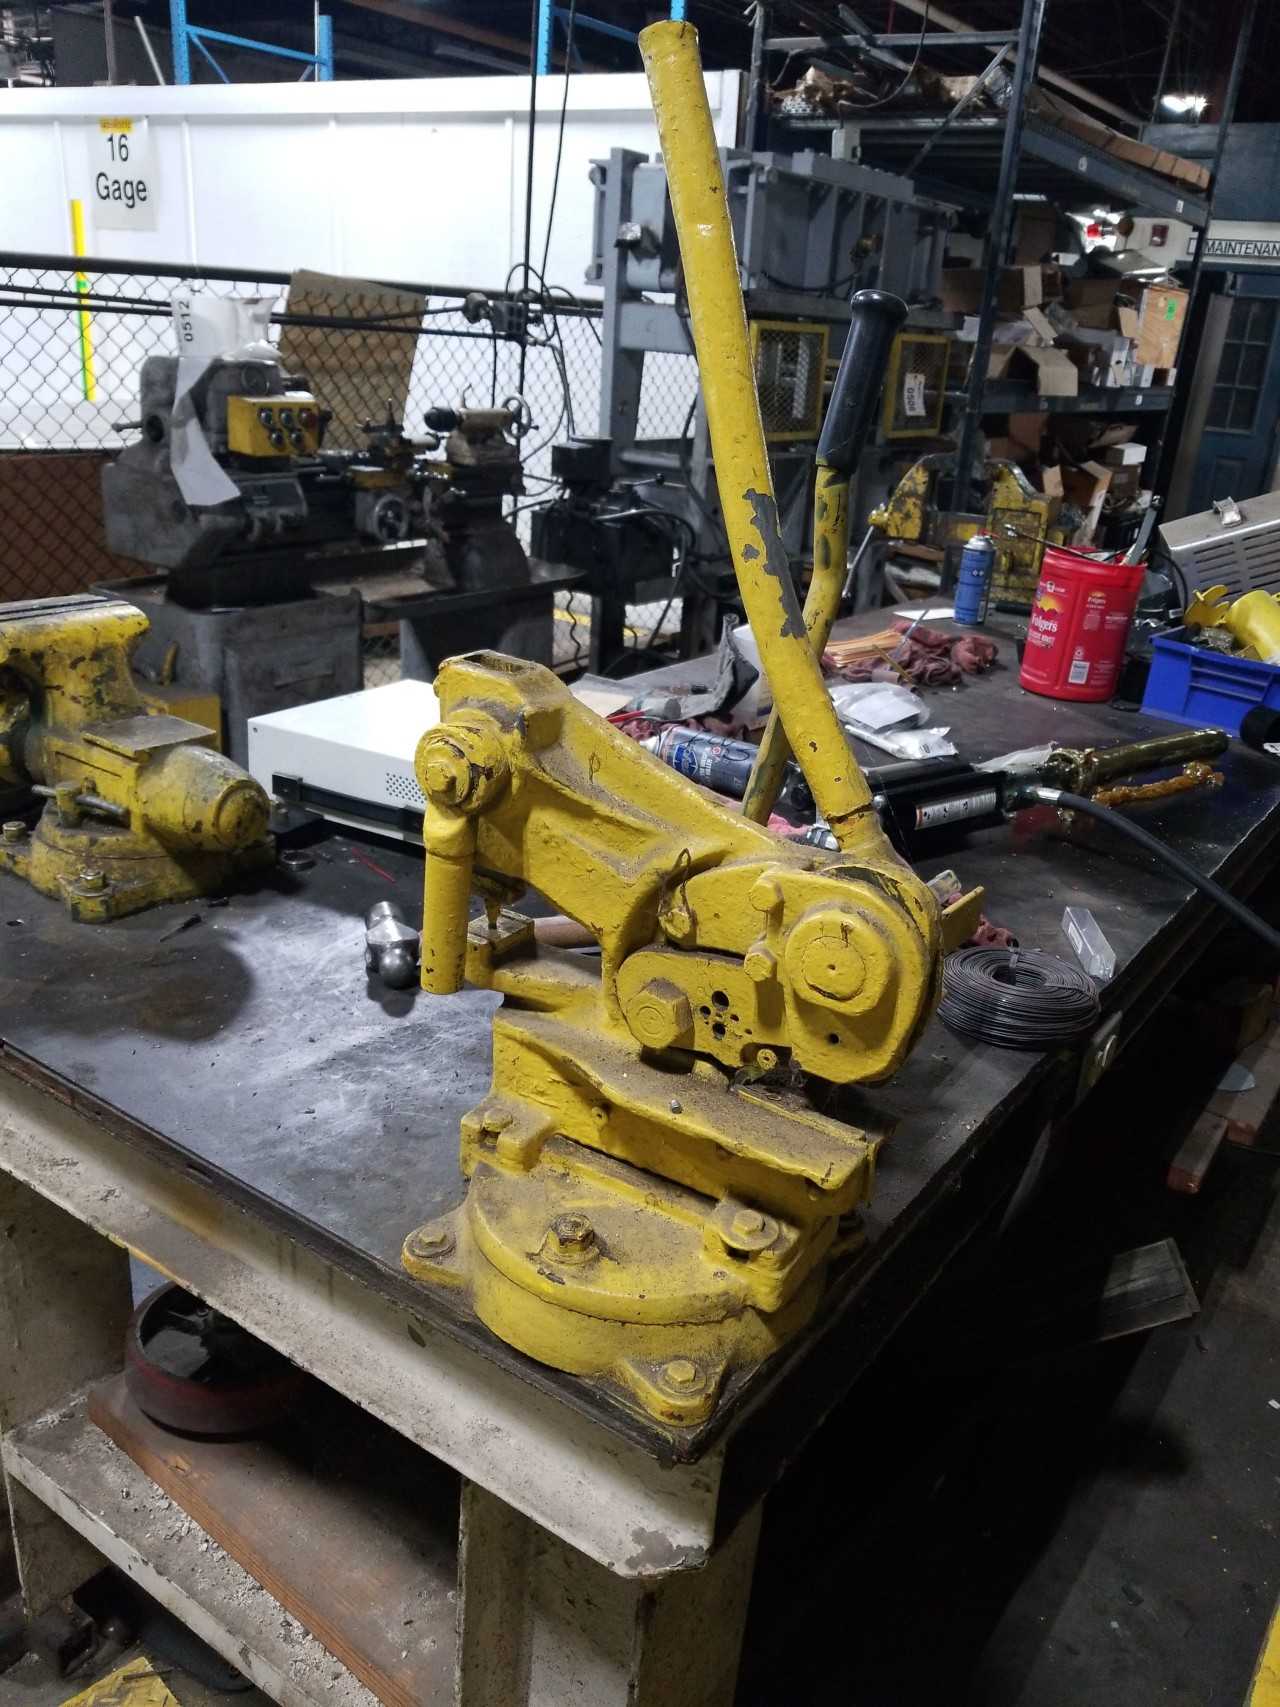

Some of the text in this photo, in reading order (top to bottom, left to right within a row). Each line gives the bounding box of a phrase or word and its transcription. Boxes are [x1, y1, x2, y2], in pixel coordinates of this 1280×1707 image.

[107, 133, 129, 162] 16
[96, 171, 148, 209] Gage
[179, 301, 194, 342] 0512
